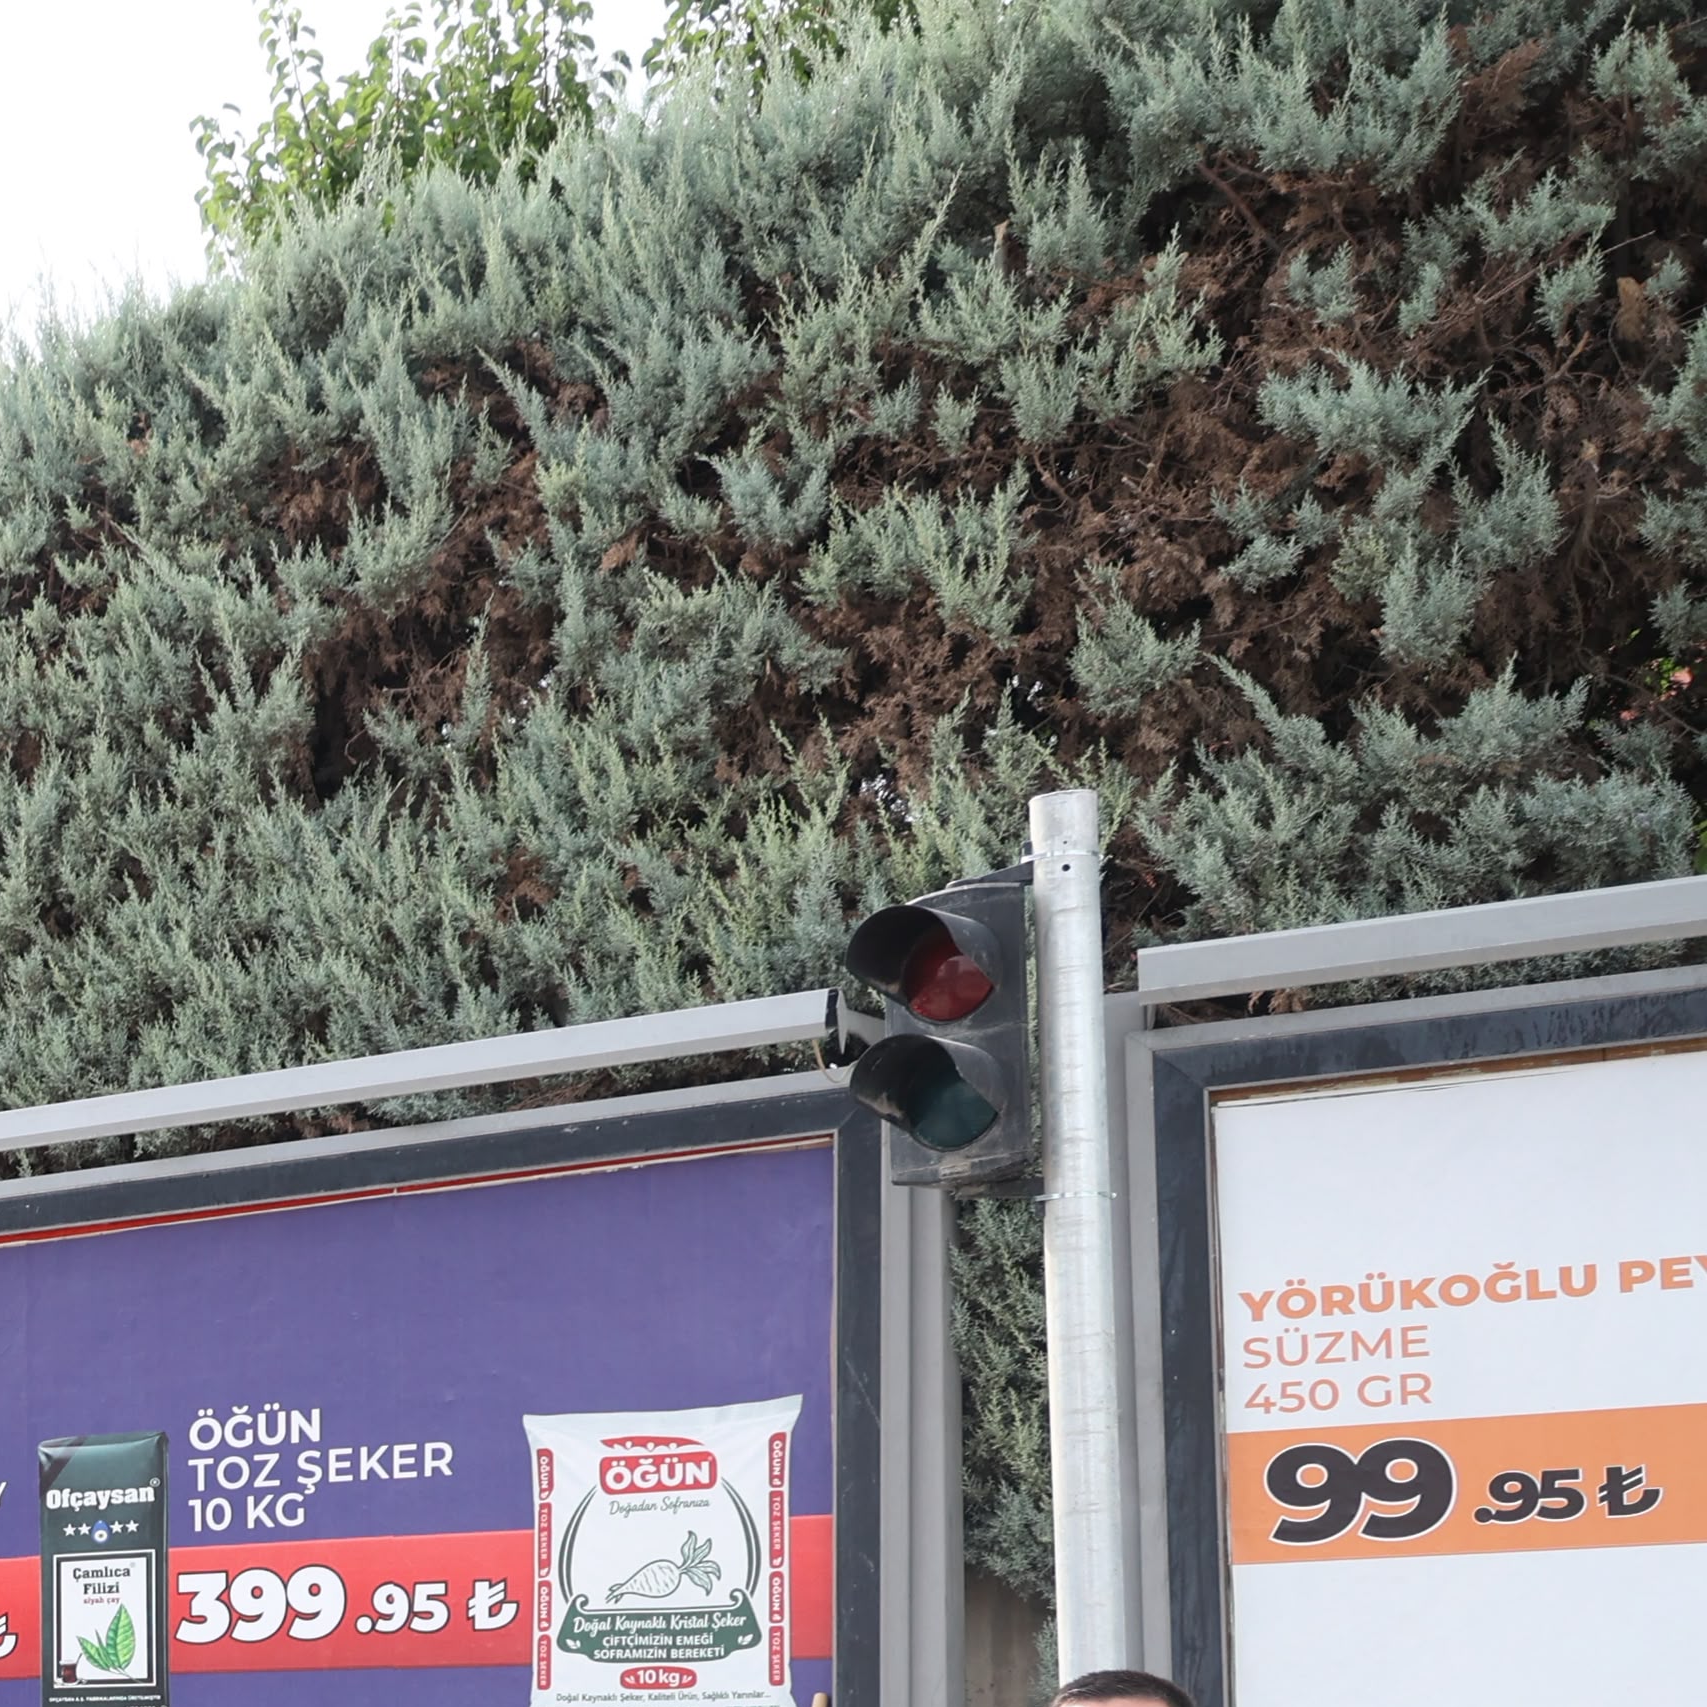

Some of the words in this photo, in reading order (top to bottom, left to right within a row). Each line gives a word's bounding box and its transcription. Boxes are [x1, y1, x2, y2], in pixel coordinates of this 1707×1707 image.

[1238, 1261, 1598, 1322] YÖRÜKOĞLU
[1242, 1324, 1431, 1369] SÜZME
[1243, 1378, 1340, 1415] 450
[1356, 1372, 1433, 1408] GR
[188, 1402, 322, 1451] ÖĞÜN
[188, 1454, 290, 1492] TOZ
[296, 1440, 454, 1494] ŞEKER
[605, 1456, 711, 1491] ÖĞÜN
[46, 1486, 155, 1512] Ofçaysan
[609, 1499, 657, 1518] Doğadan
[188, 1496, 232, 1533] 10
[246, 1493, 307, 1529] KG
[72, 1565, 131, 1582] Çamlıca
[83, 1581, 120, 1595] Filizi
[573, 1616, 612, 1637] Doğal
[614, 1615, 667, 1636] Kaynaklı
[669, 1614, 709, 1630] Kristal
[711, 1612, 747, 1631] Şeker
[602, 1634, 674, 1649] ÇİFTÇİMİZİN
[676, 1632, 714, 1646] EMEĞİ
[670, 1645, 725, 1658] BEREKETİ
[636, 1669, 656, 1684] 10
[658, 1669, 681, 1688] kg
